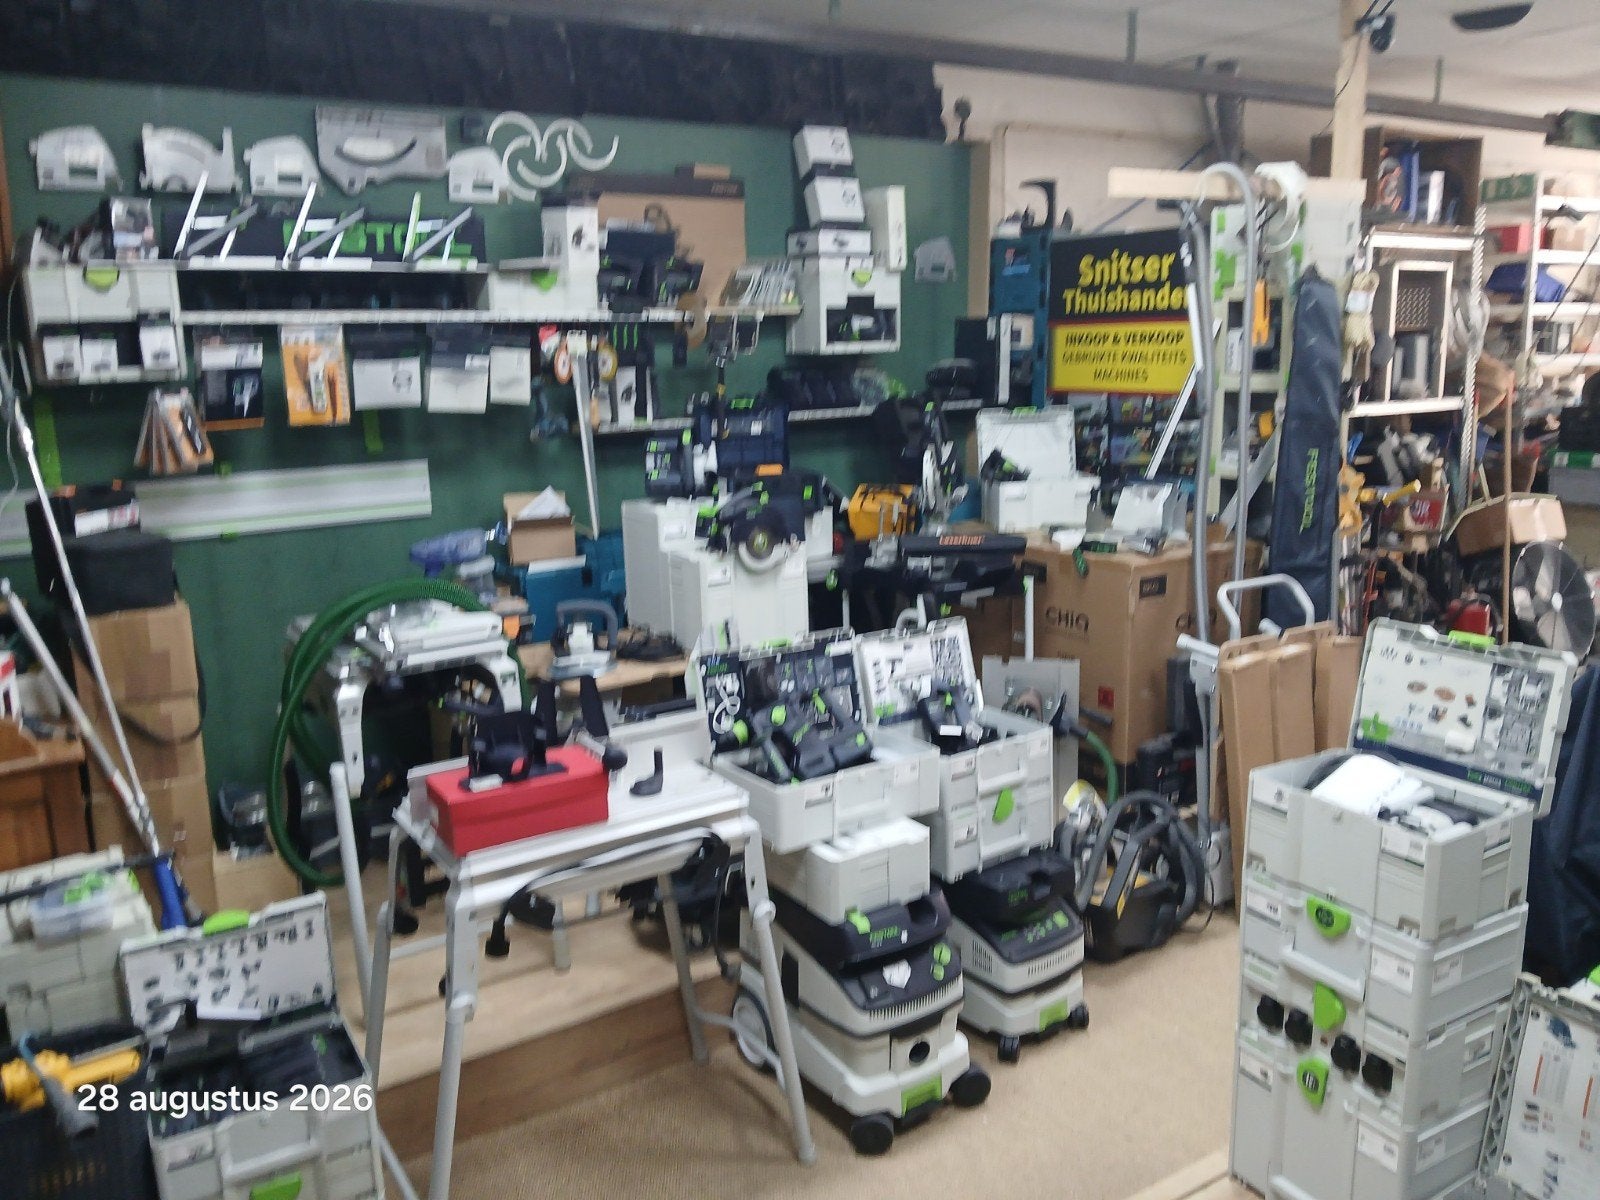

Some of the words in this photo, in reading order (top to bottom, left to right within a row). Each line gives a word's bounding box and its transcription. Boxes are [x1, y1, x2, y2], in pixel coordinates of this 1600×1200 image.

[1078, 248, 1177, 287] Snitser
[1066, 331, 1109, 348] INKOOP
[1126, 328, 1185, 345] VERKOOP
[1093, 367, 1150, 382] MACHINES
